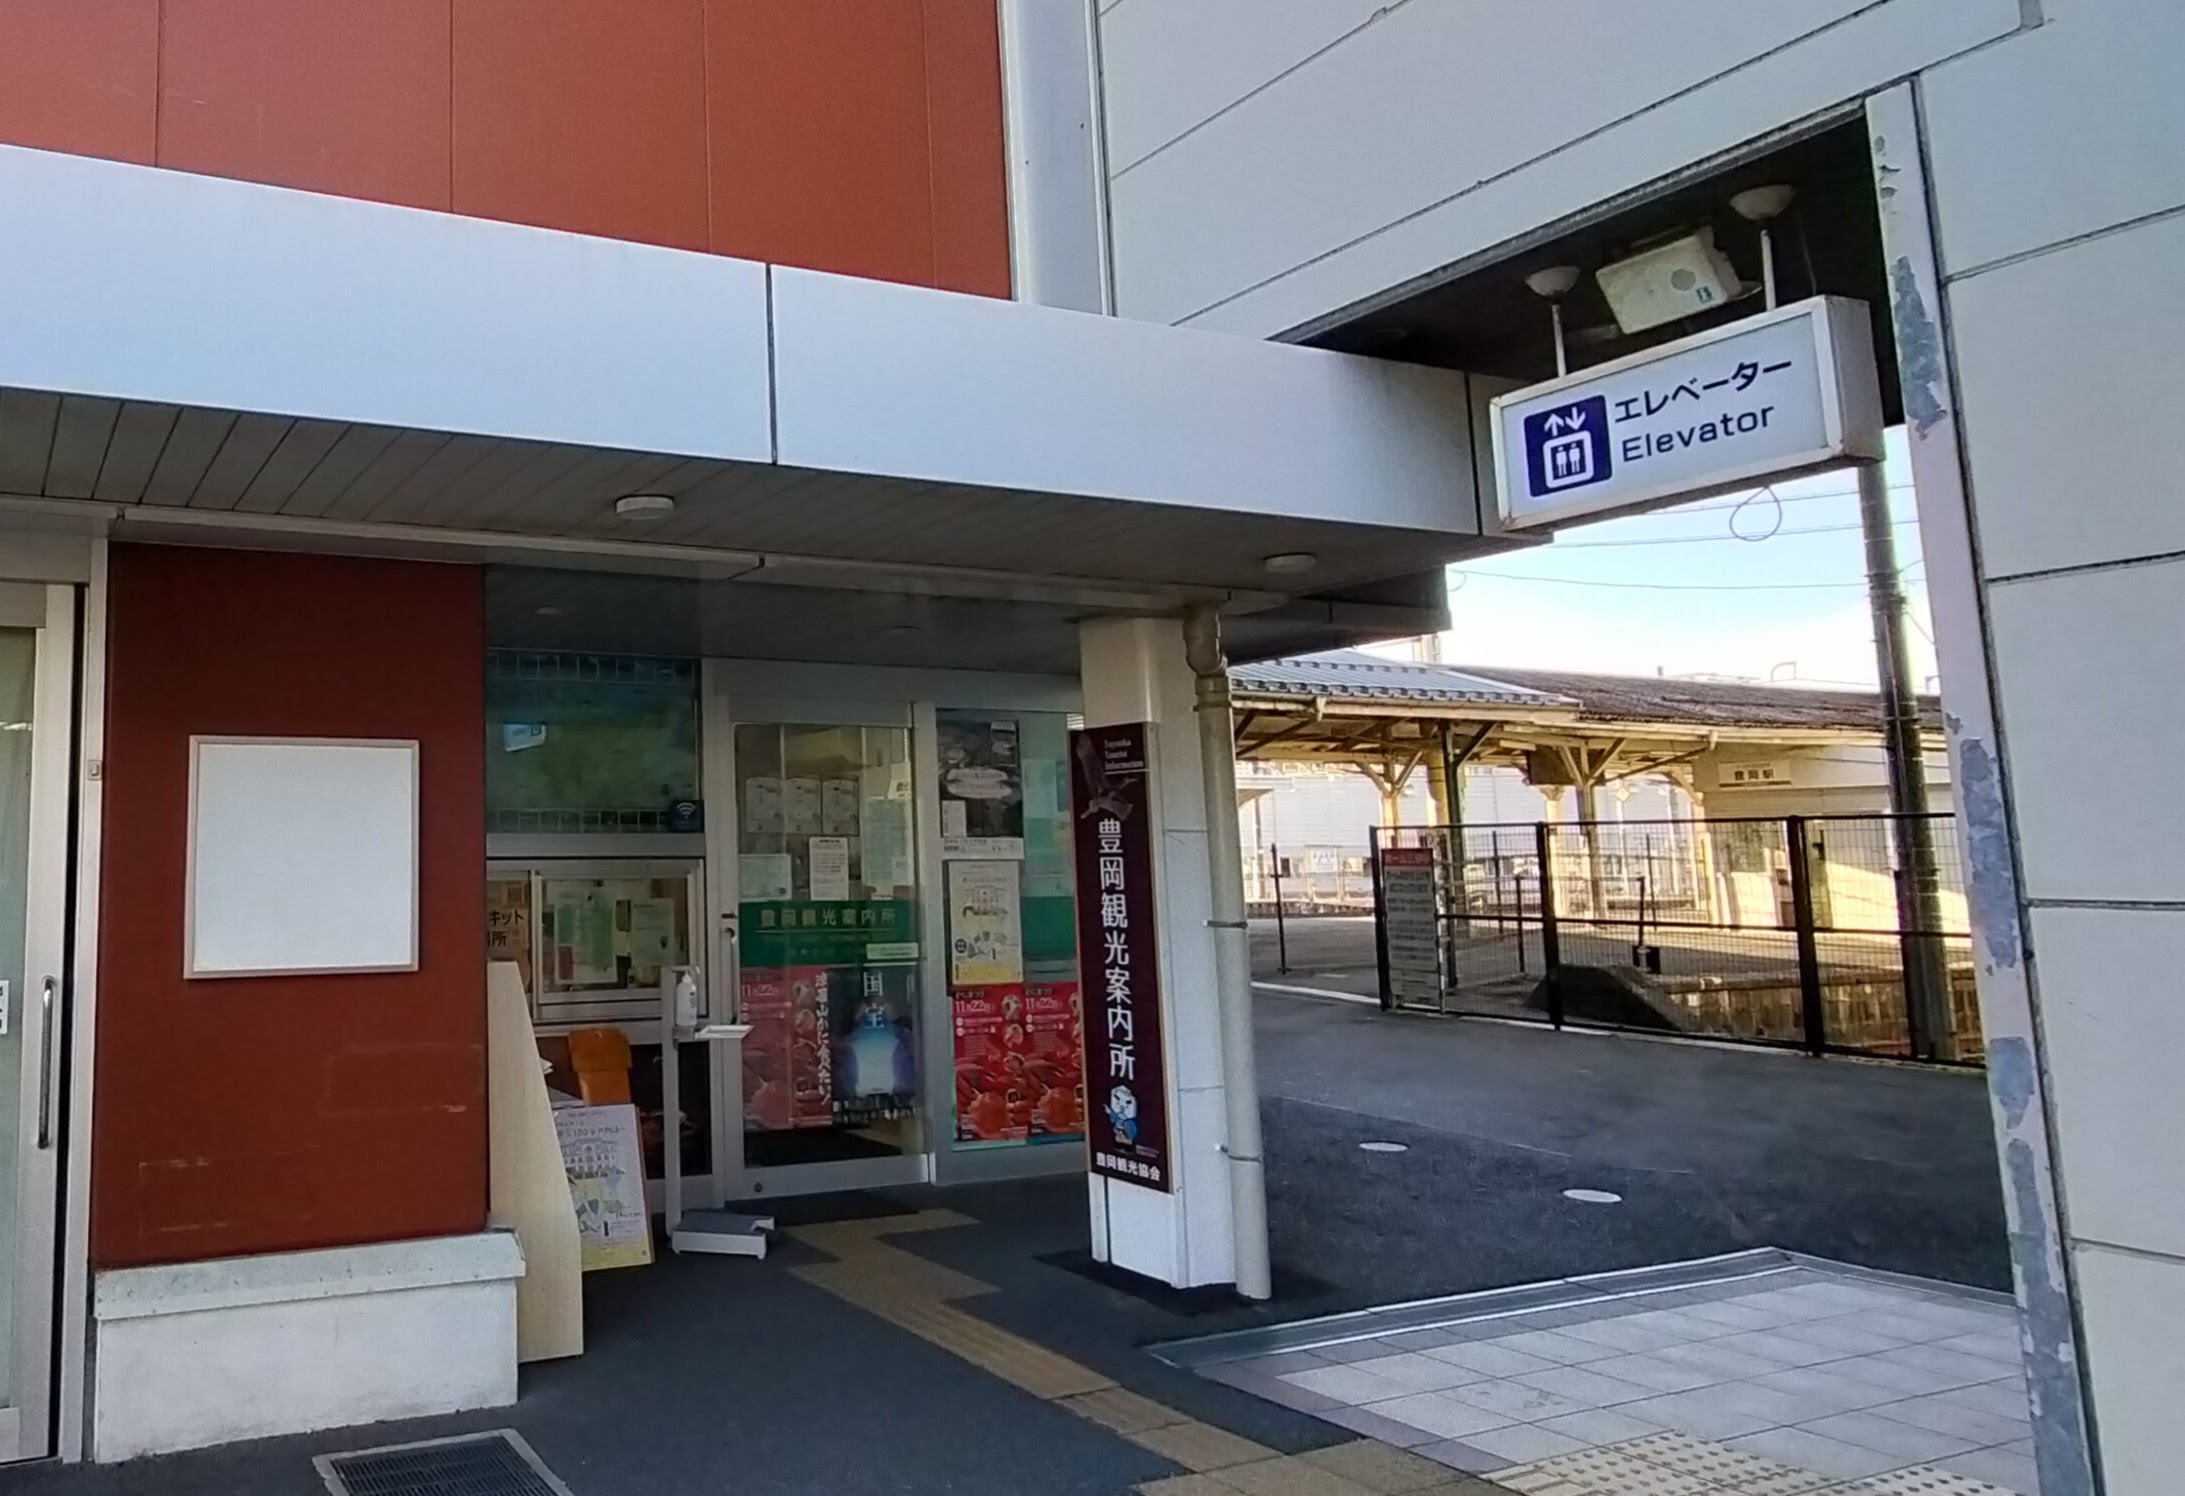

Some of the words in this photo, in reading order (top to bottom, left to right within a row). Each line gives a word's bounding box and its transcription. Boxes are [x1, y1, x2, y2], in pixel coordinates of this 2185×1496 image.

[1614, 360, 1792, 424] エレベーター
[1622, 404, 1775, 463] Elevator
[1098, 817, 1136, 1081] 豊岡観光案内所
